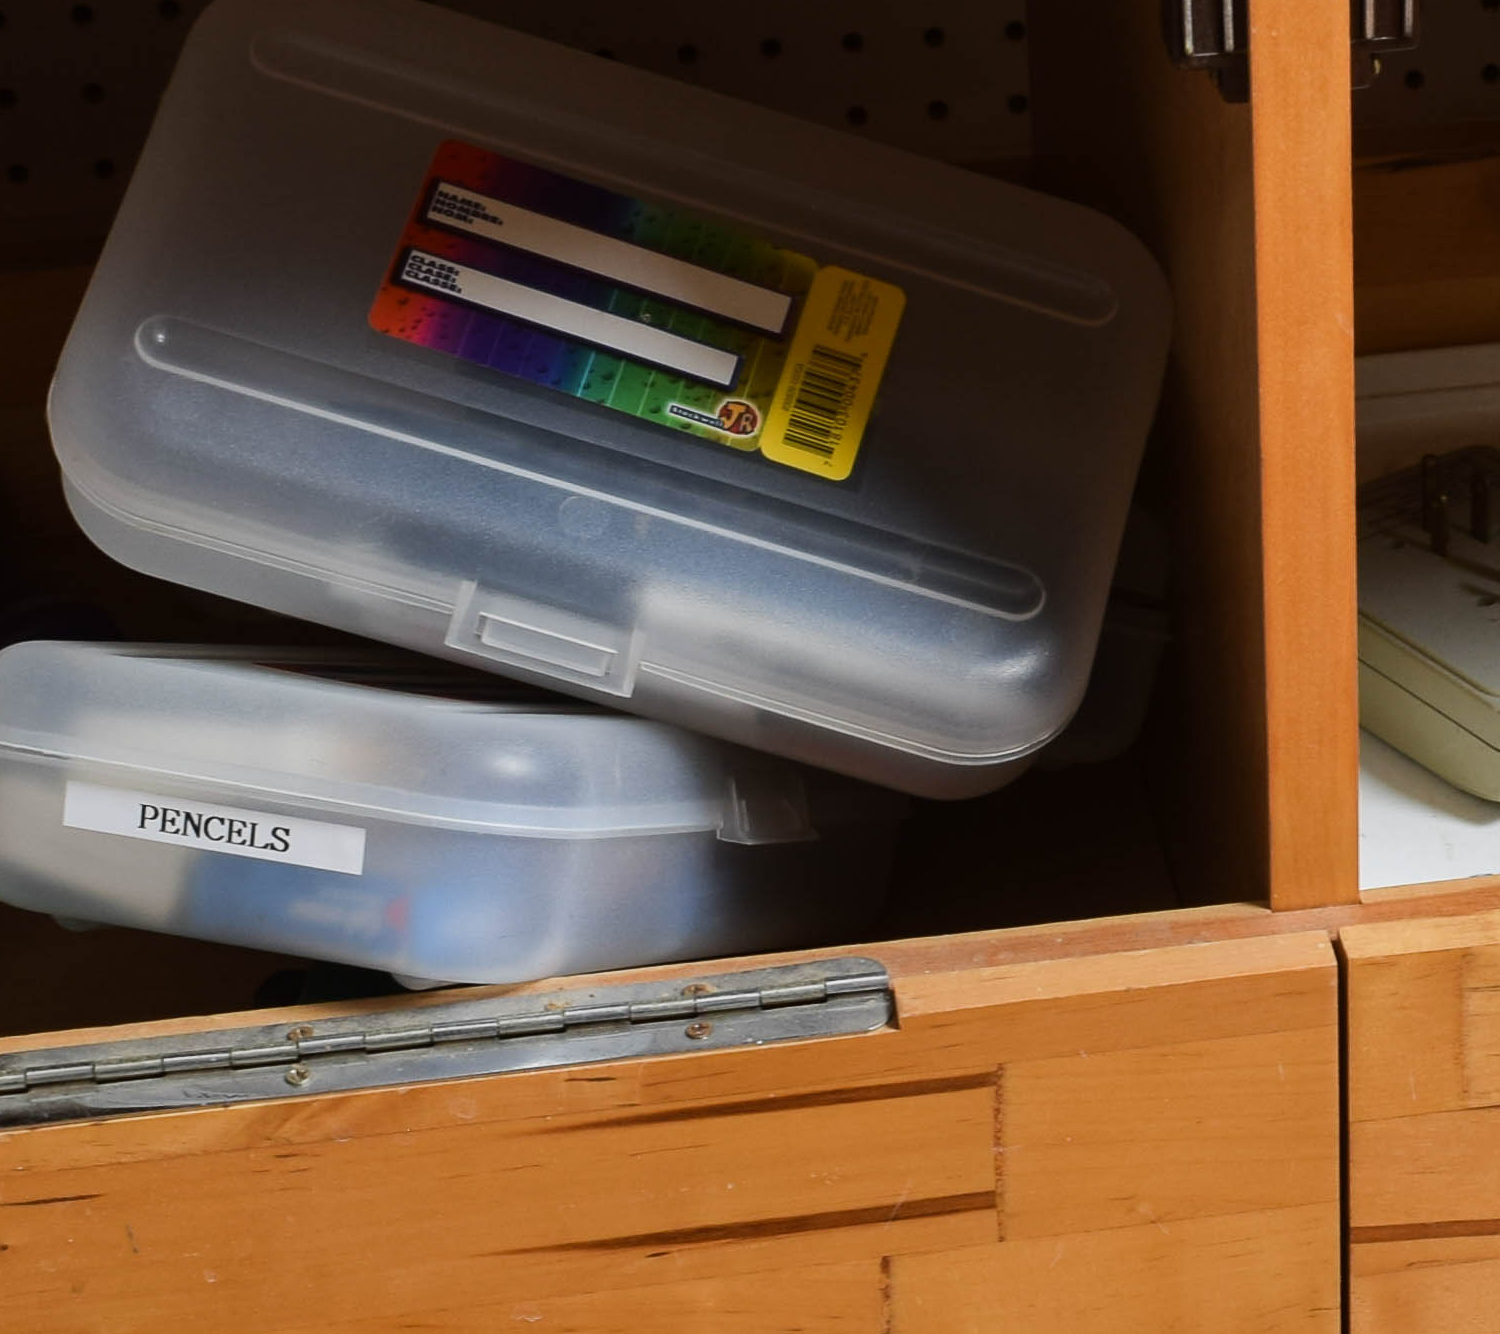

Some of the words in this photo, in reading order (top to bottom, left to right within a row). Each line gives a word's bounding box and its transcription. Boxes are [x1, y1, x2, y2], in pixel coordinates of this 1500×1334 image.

[408, 263, 456, 283] CLASE:
[411, 255, 459, 275] CLASS:
[404, 271, 462, 293] CLASSE:
[138, 803, 290, 861] PENCELS
